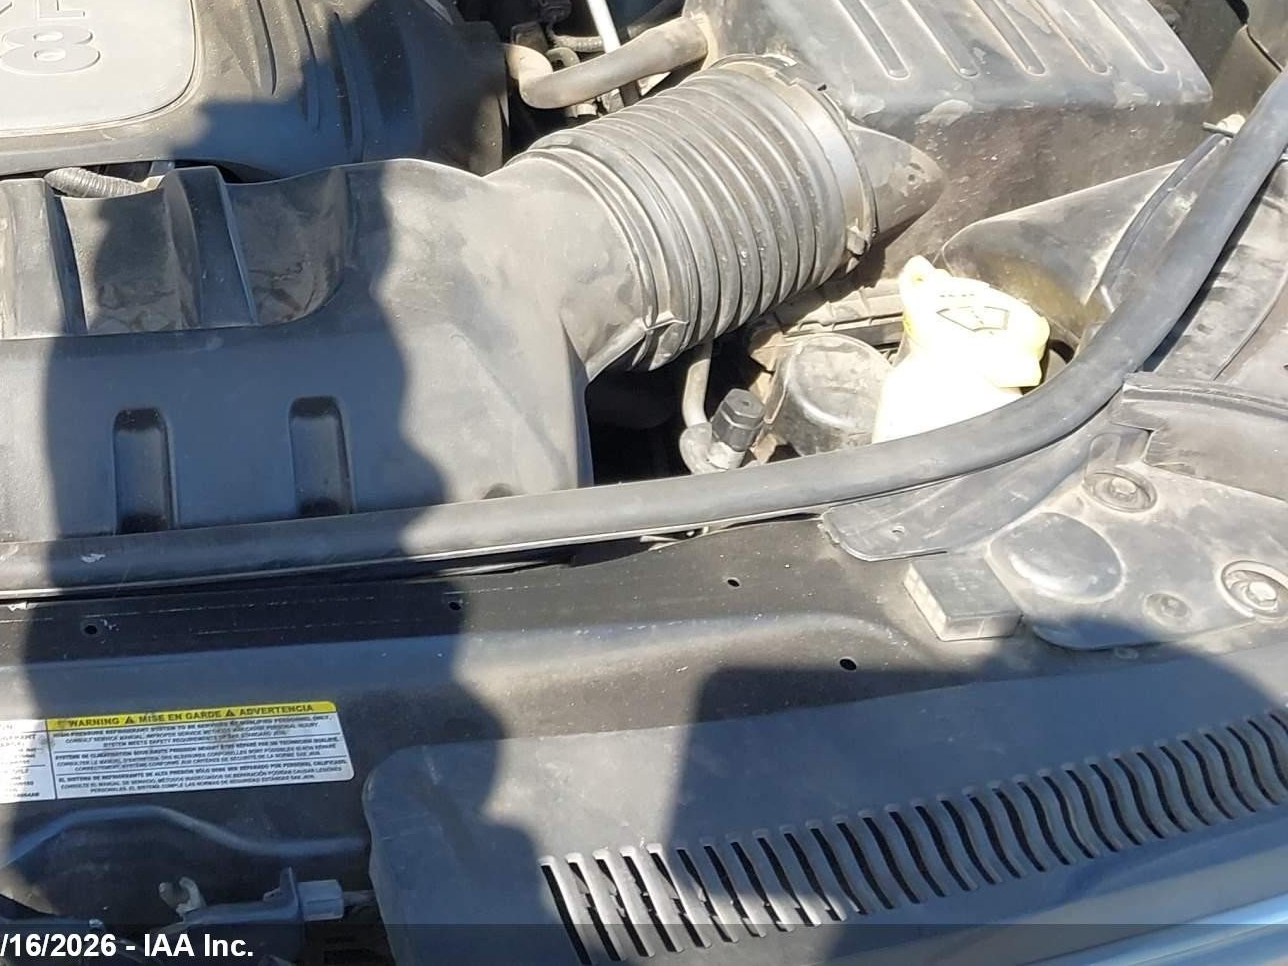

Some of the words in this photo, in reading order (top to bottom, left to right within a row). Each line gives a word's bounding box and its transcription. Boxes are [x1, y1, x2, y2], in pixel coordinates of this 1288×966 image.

[69, 716, 120, 727] WARNING
[137, 714, 165, 722] MISE
[167, 712, 182, 720] EN
[184, 710, 222, 719] GARDE
[238, 704, 313, 715] ADVERTENCIA
